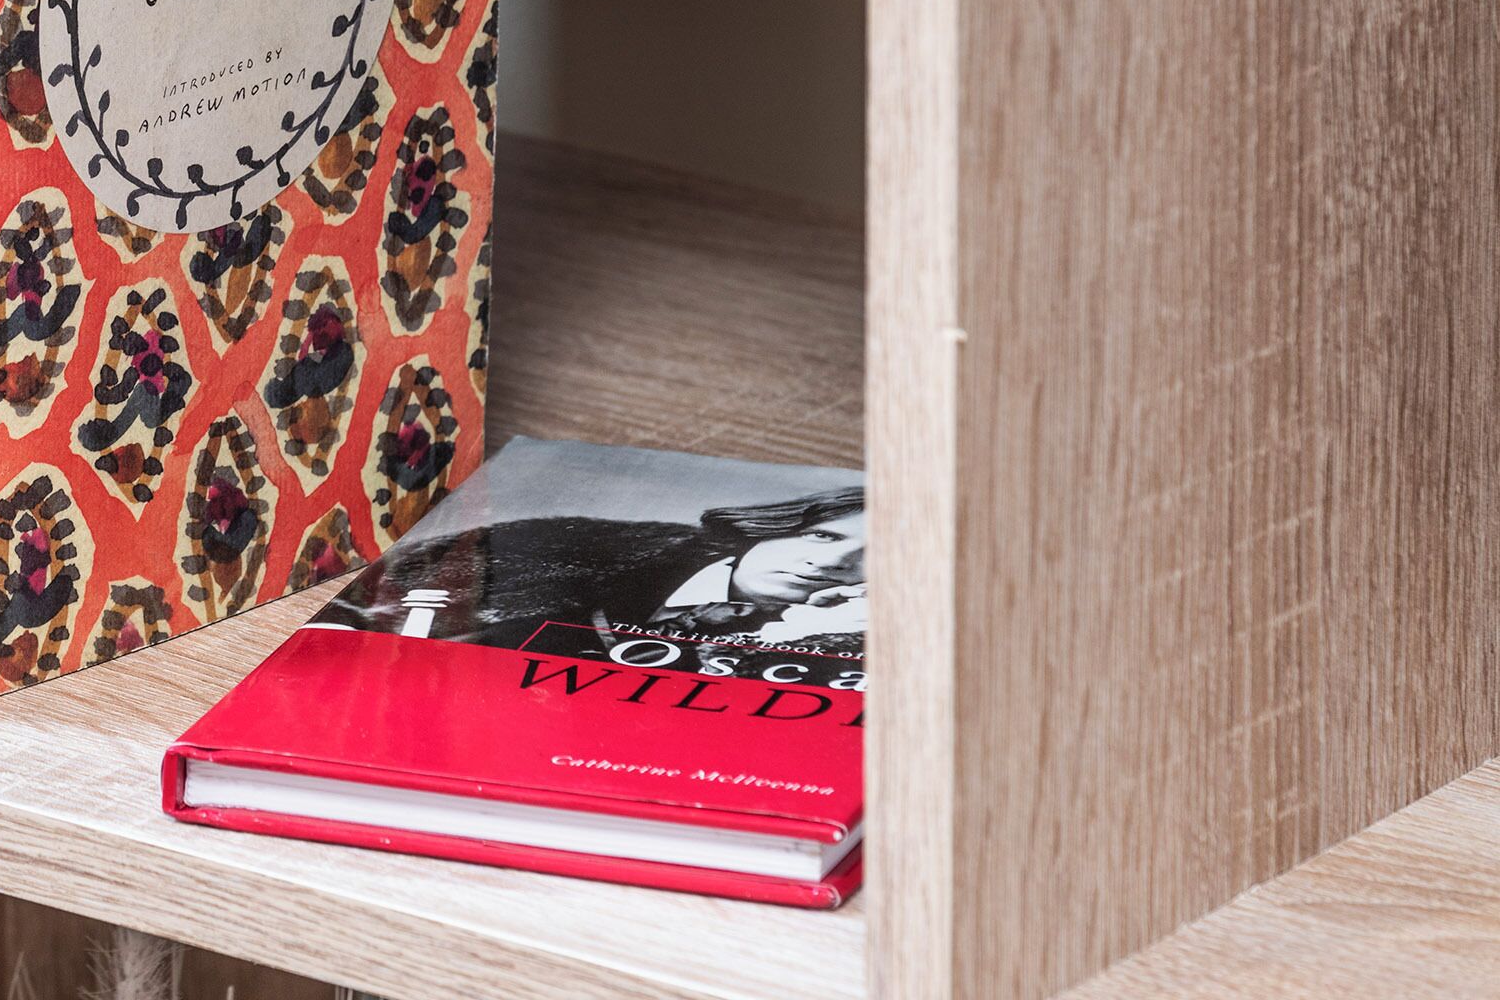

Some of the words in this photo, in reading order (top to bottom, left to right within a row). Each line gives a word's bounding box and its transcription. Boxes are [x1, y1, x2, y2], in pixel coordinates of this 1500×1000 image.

[163, 59, 254, 98] INTRODUCED
[265, 47, 284, 63] BY
[139, 96, 223, 133] ANDREW
[233, 68, 306, 102] MOTION
[612, 622, 660, 637] The
[757, 640, 824, 656] Book
[551, 755, 681, 777] Catherine
